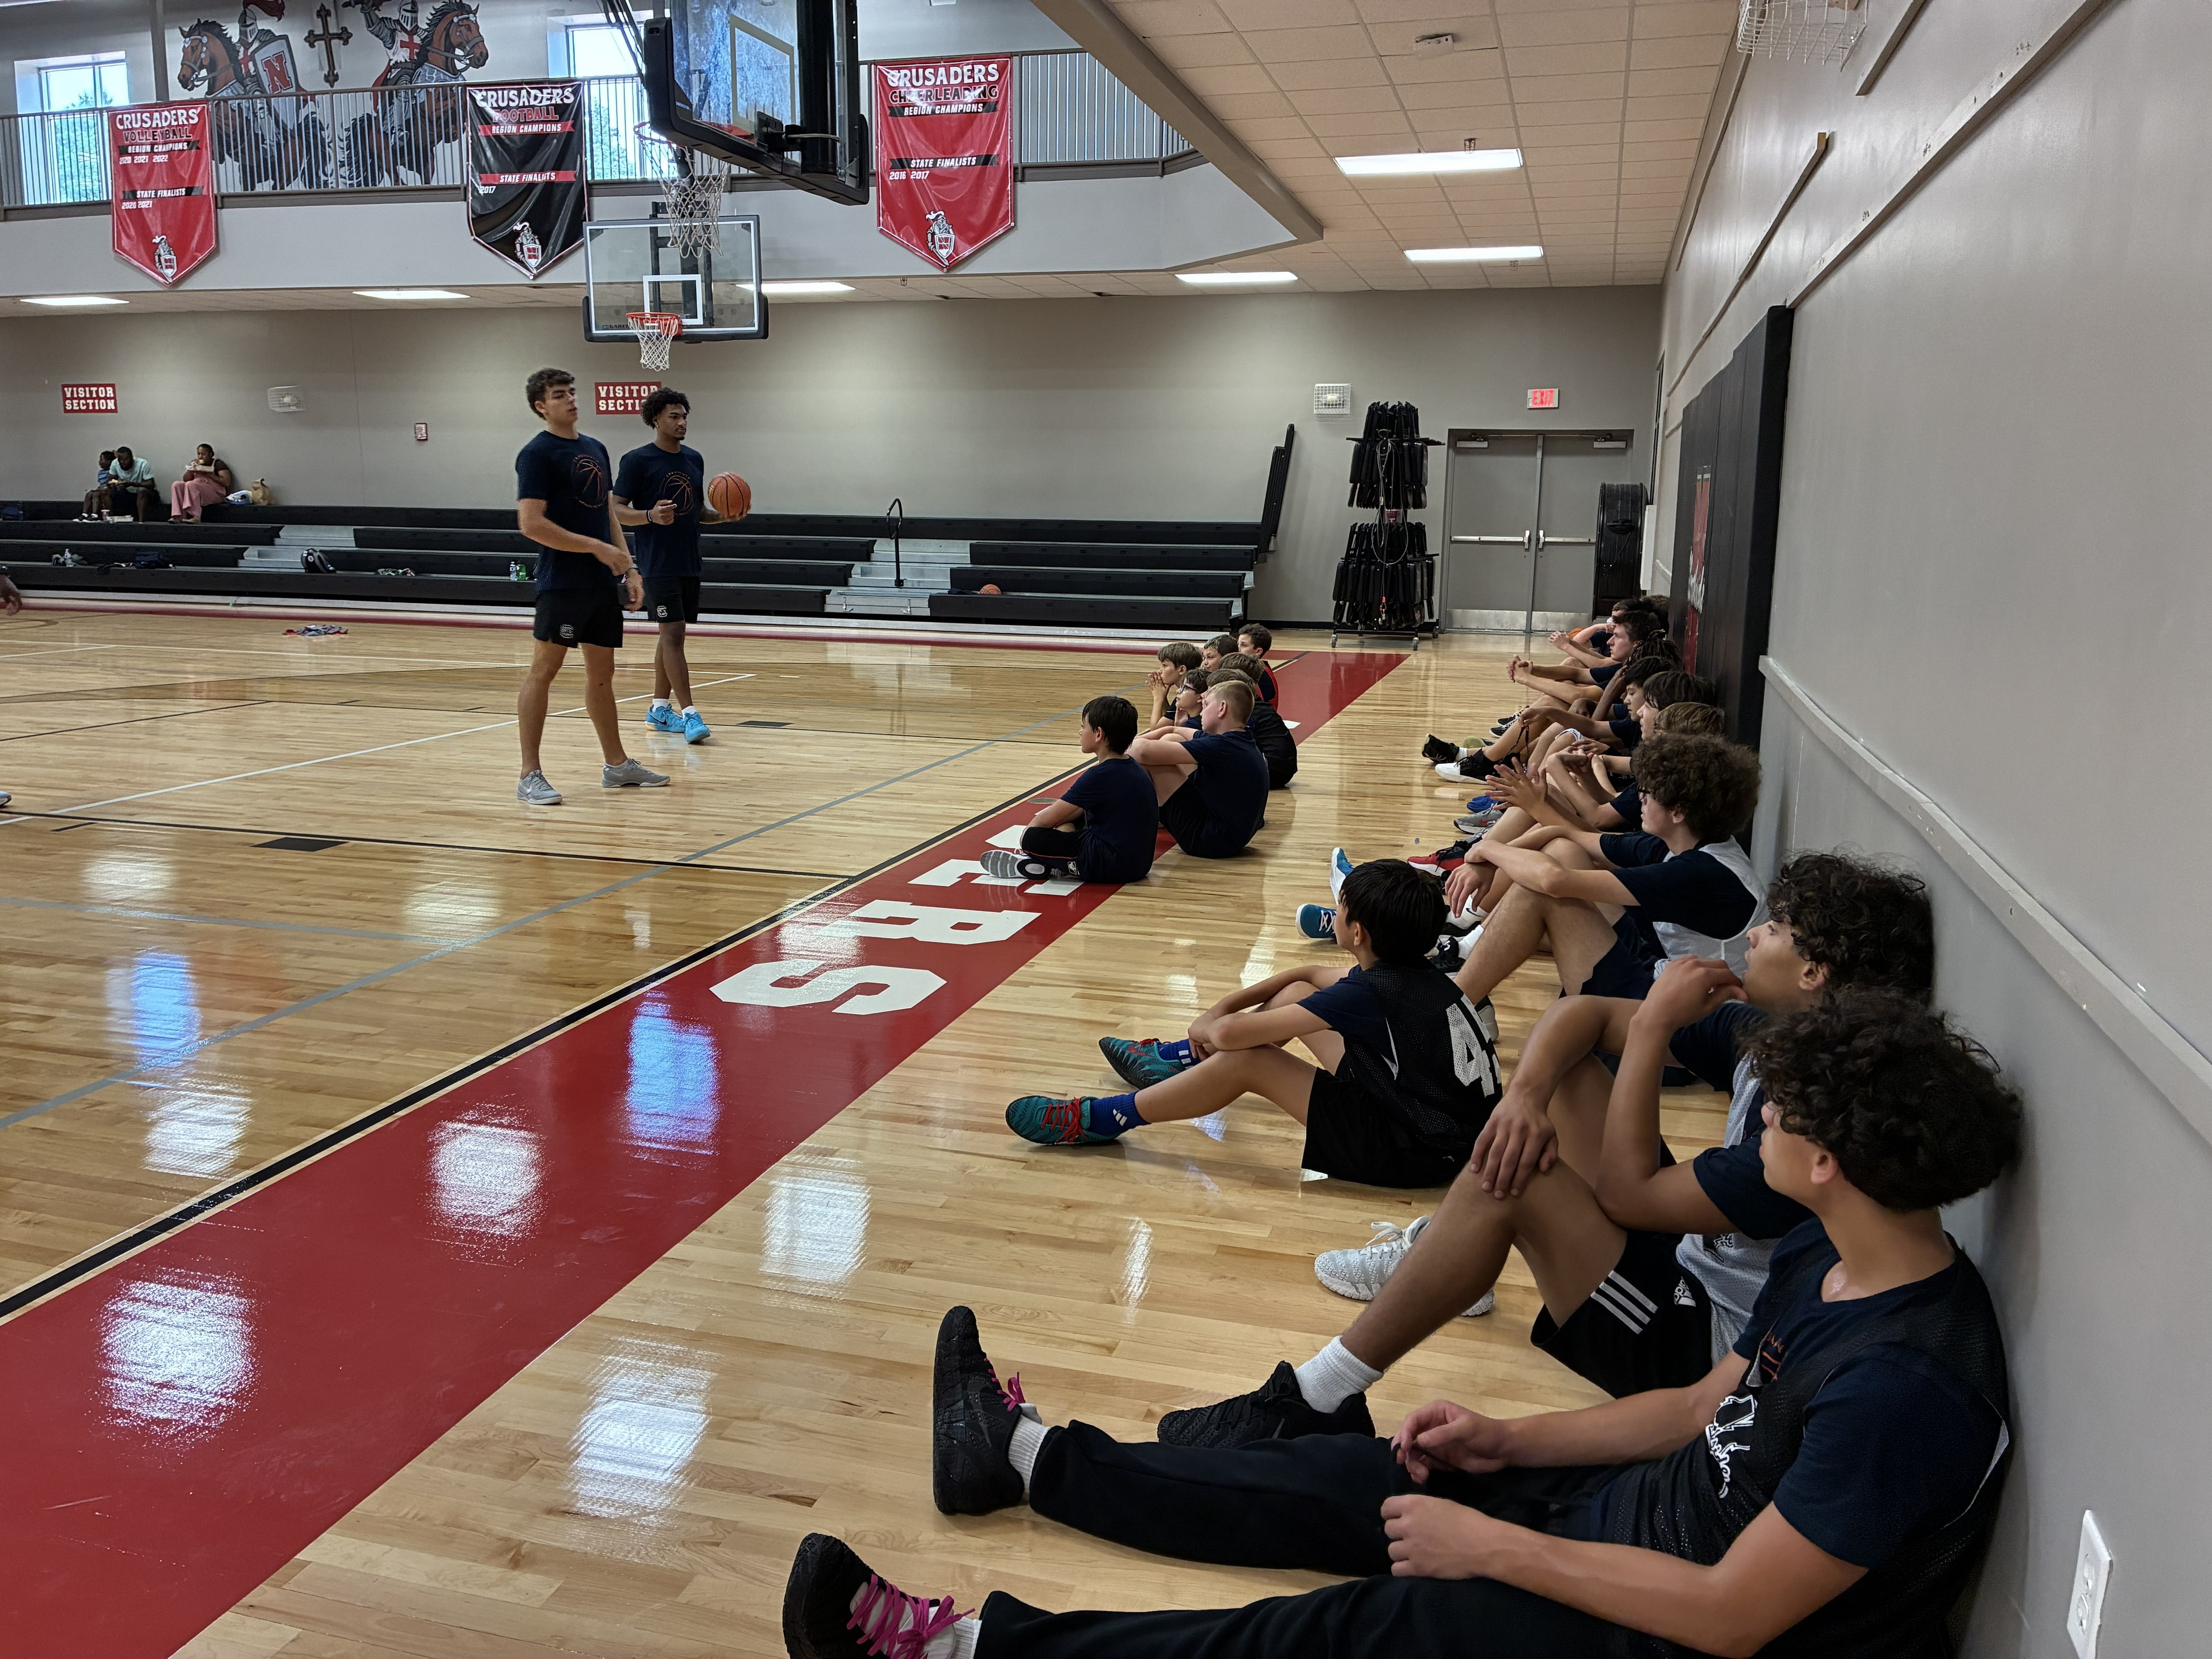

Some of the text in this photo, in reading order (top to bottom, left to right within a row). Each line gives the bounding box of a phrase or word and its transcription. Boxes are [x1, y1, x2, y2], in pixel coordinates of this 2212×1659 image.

[262, 51, 293, 94] N
[887, 64, 999, 86] CRUSADERS
[476, 88, 574, 107] CRUSADERS
[889, 85, 998, 104] CHEERLEADING
[493, 107, 559, 122] FOOTBALL
[904, 103, 983, 115] REGION CHAMPIONS
[116, 109, 199, 130] CRUSADERS
[492, 124, 562, 134] REGION CHAMPIONS
[123, 127, 192, 143] VOLLEYBALL
[128, 142, 188, 153] REGION CHAMPIONS
[153, 154, 168, 162] 2022
[910, 157, 976, 168] STATE FINALISTS
[500, 175, 520, 183] STATE
[889, 171, 930, 180] 2016 2017
[137, 188, 185, 198] STATE FINALISTS
[479, 185, 496, 194] 2017
[138, 200, 152, 209] 2021
[64, 387, 114, 397] VISITOR
[1533, 389, 1555, 407] EXIT
[65, 399, 115, 410] SECTION
[599, 399, 646, 411] SECTI
